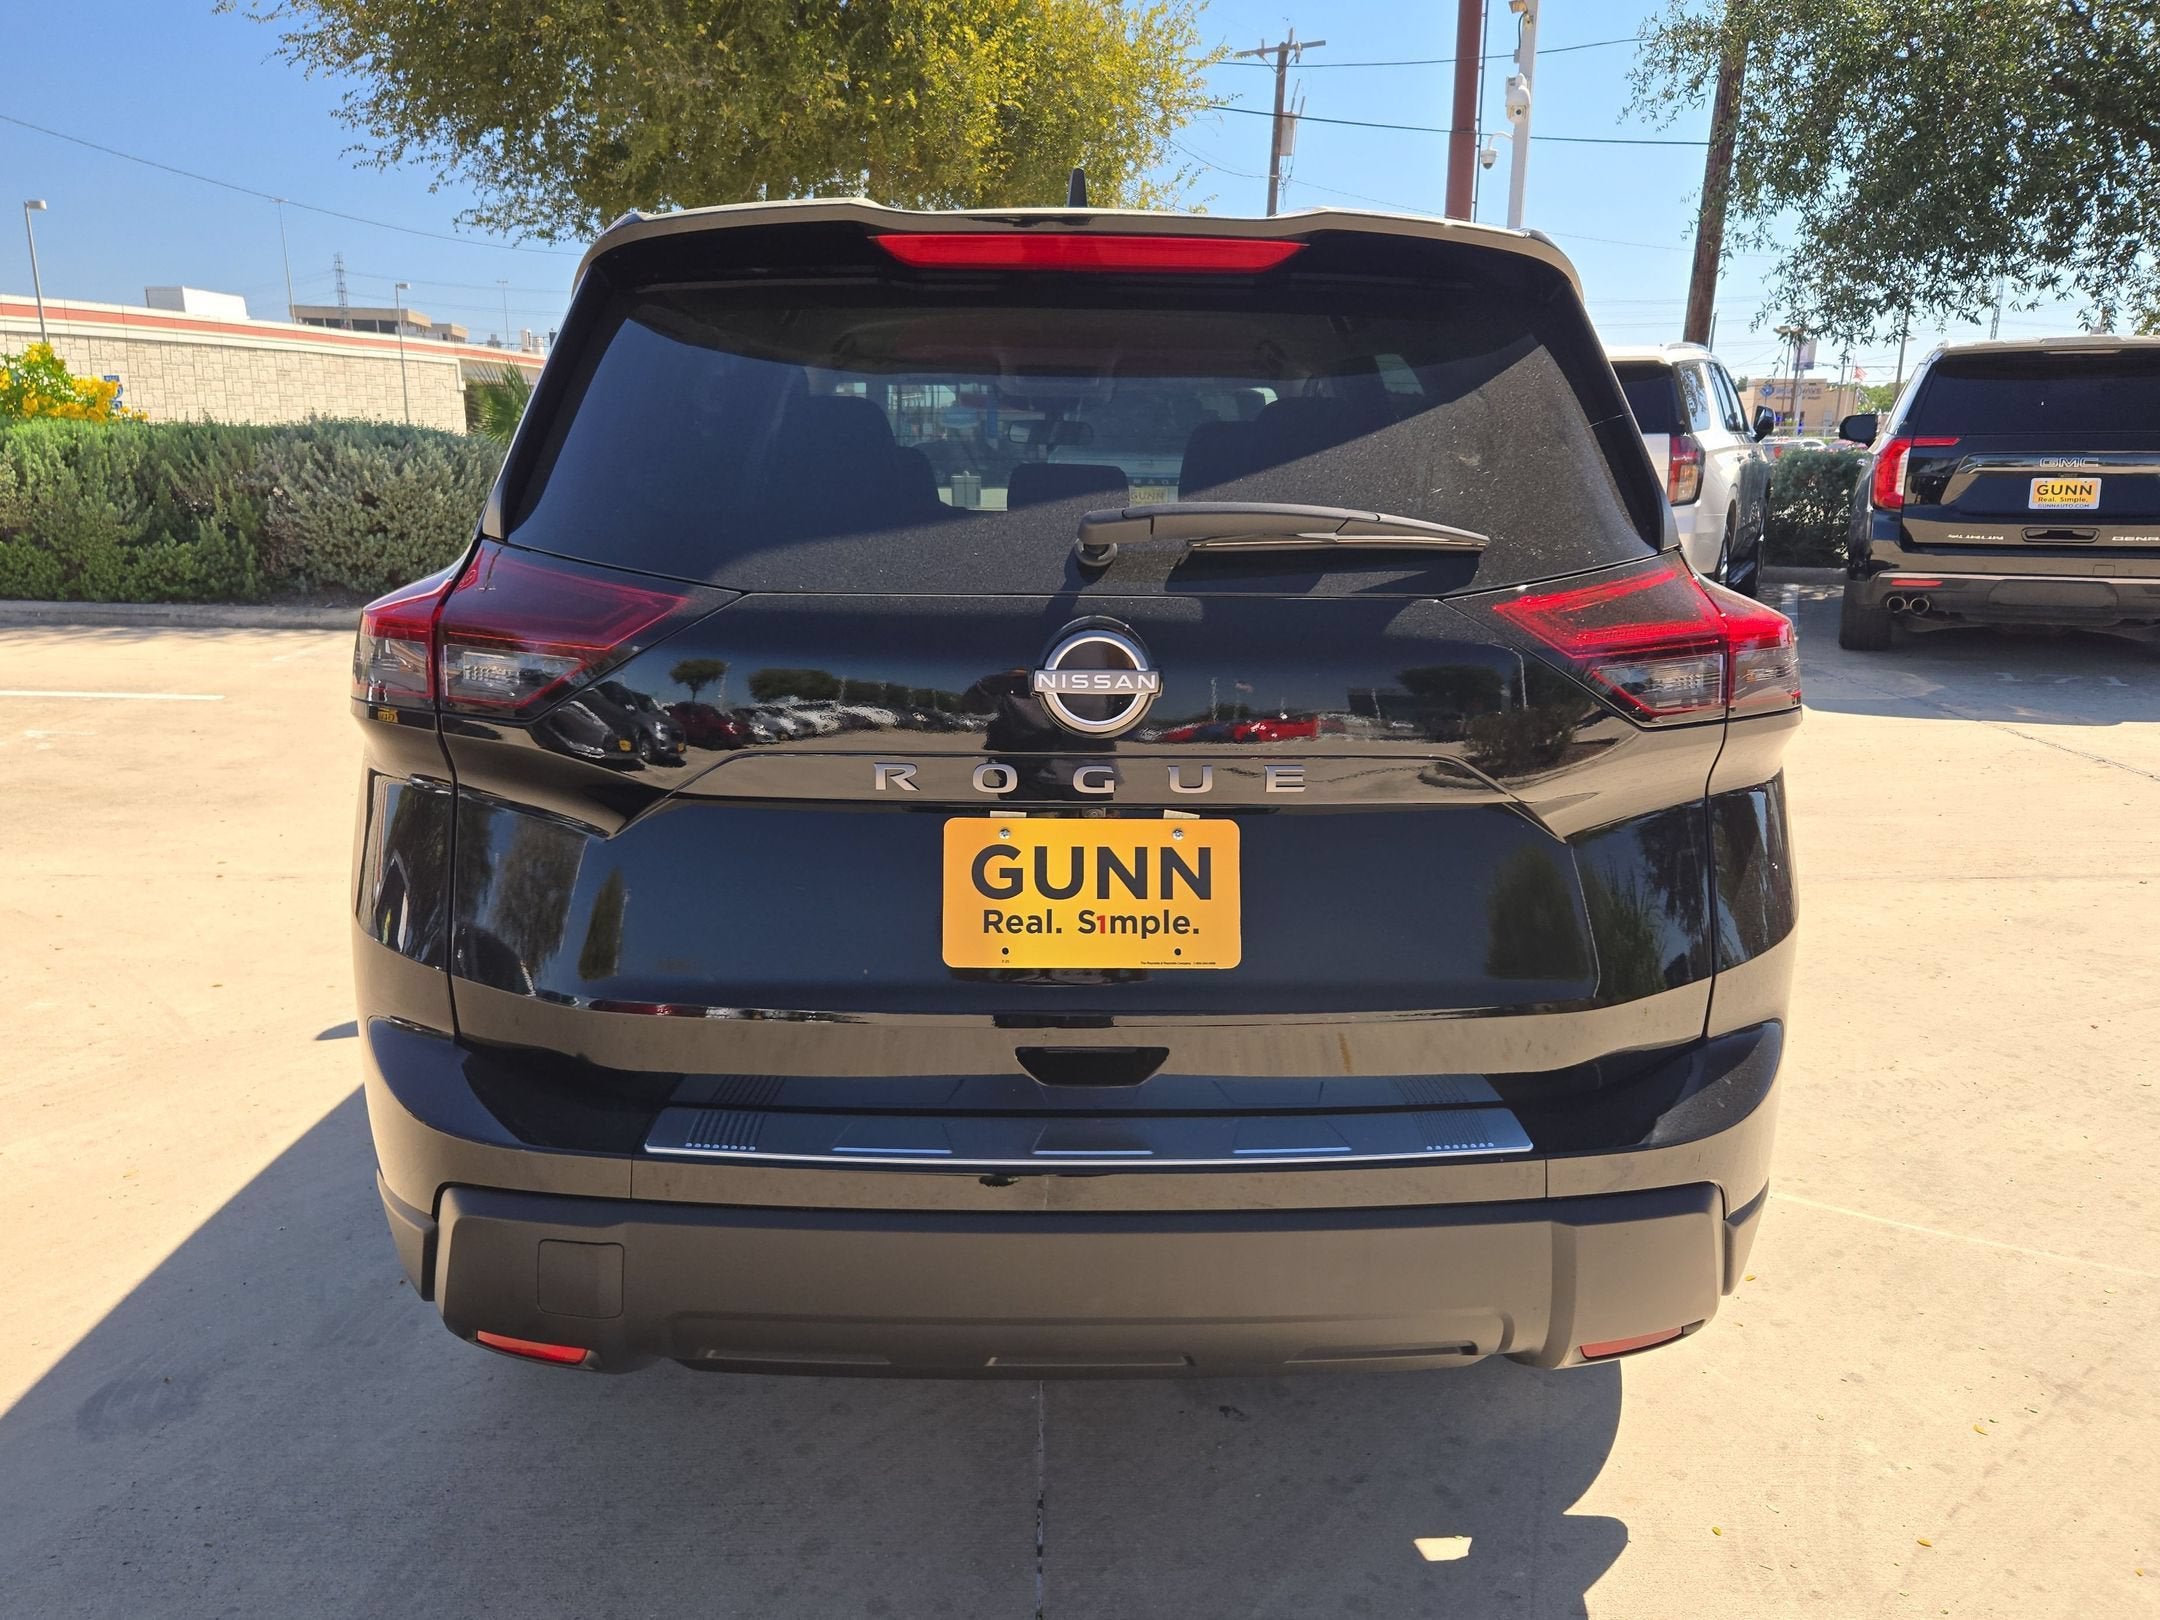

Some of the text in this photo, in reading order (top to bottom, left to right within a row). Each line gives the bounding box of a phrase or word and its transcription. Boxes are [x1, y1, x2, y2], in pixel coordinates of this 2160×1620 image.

[2040, 457, 2099, 468] GMC
[2037, 484, 2093, 496] GUNN
[1038, 673, 1157, 689] NISSAN
[873, 763, 1307, 794] ROGUE
[971, 844, 1211, 900] GUNN
[983, 909, 1062, 934] Real.
